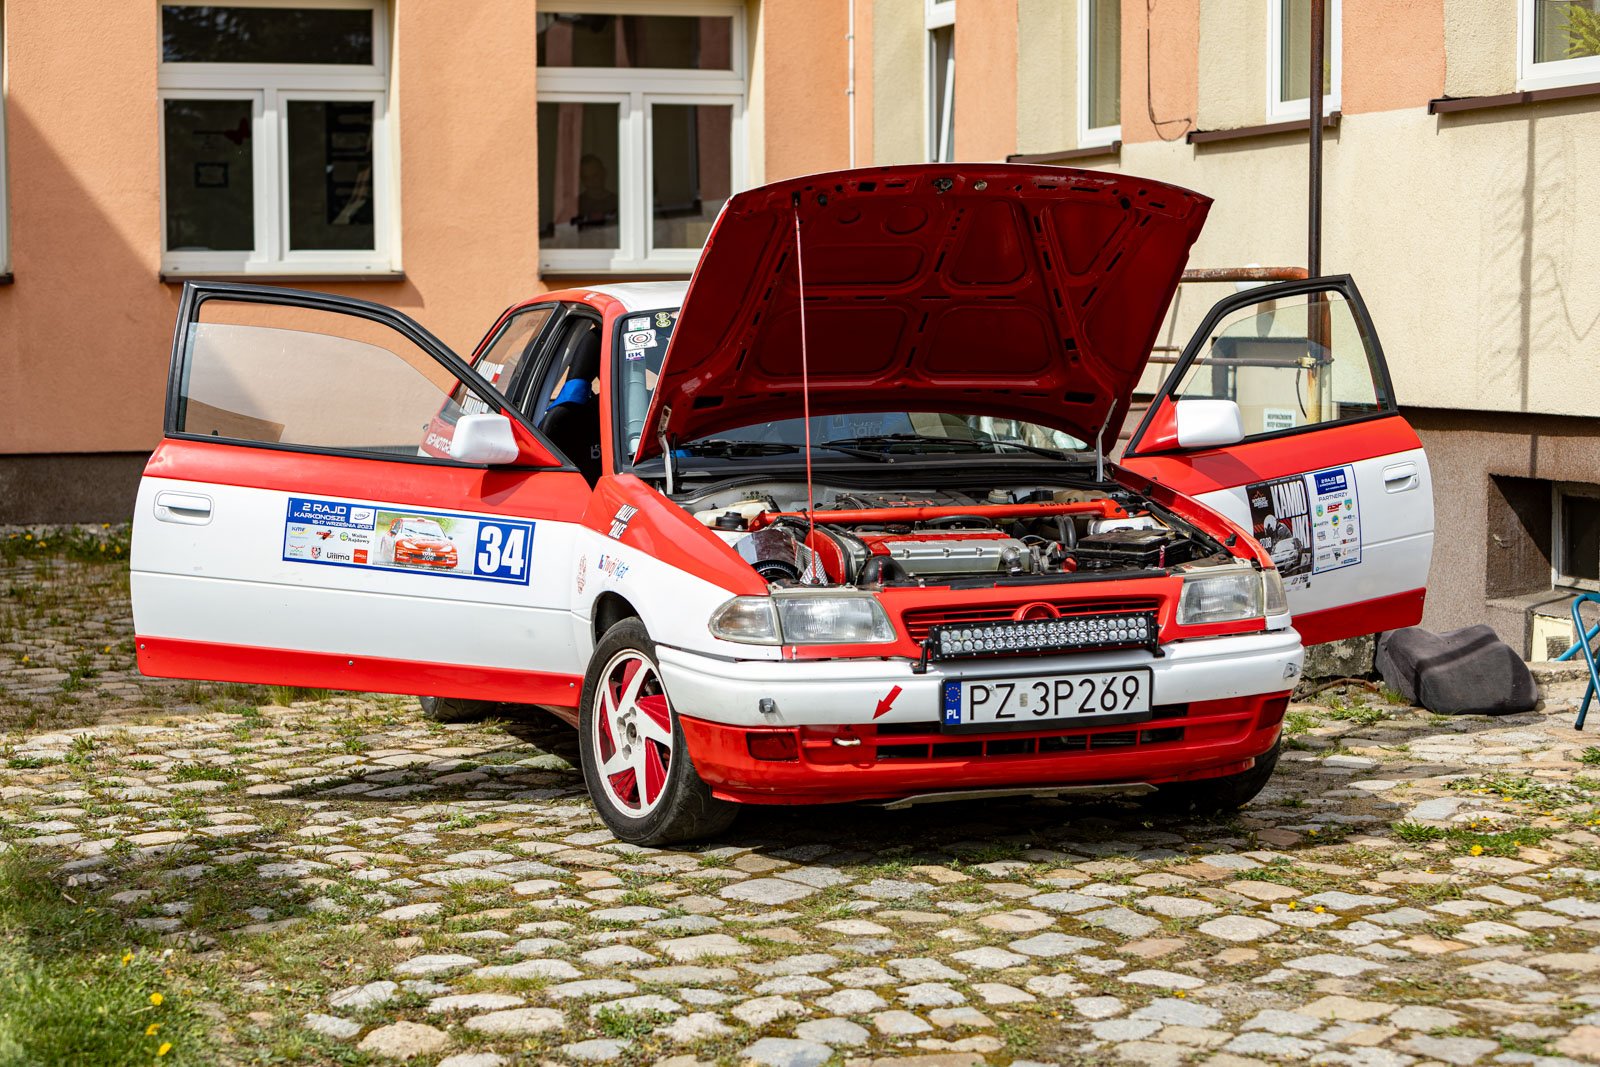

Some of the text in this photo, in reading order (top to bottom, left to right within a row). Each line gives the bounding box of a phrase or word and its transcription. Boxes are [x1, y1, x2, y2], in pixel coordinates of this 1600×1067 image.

[1270, 480, 1308, 520] KAMIO
[1318, 492, 1348, 502] PARTNERZY
[302, 502, 347, 515] 2 RAJD
[294, 511, 346, 522] KARKONOSZE
[477, 524, 526, 576] 34
[969, 675, 1140, 720] PZ 3P269
[946, 709, 960, 720] PL
